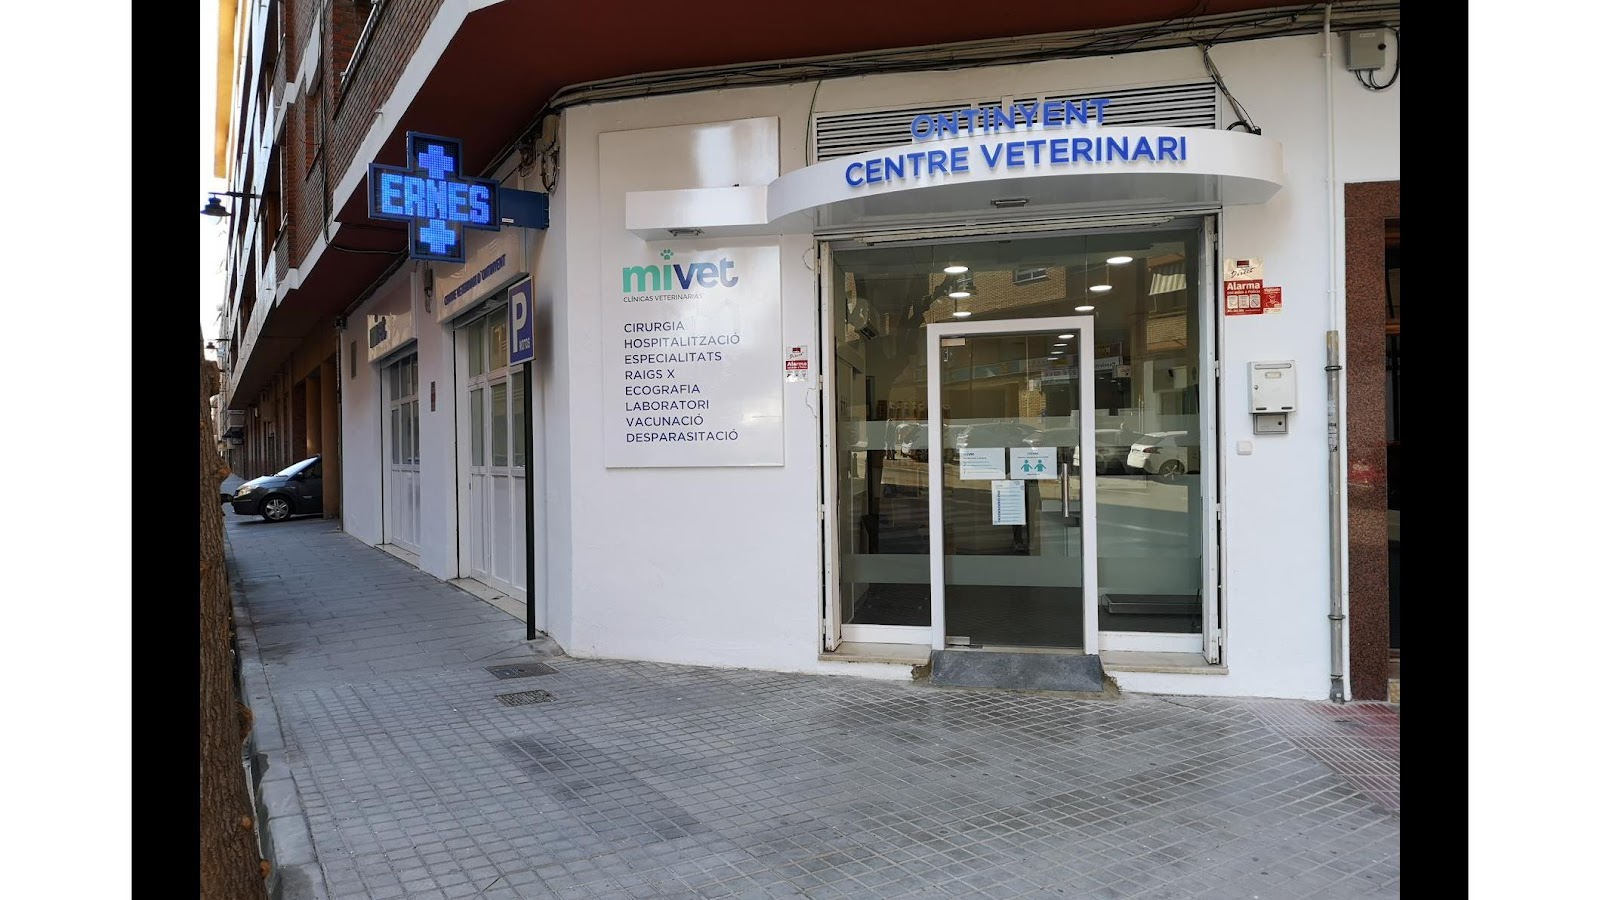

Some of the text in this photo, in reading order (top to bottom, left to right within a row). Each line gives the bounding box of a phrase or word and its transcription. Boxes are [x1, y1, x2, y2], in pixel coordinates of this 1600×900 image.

[911, 98, 1110, 140] ONTINYENT
[845, 136, 1187, 187] CENTRE VETERINARI
[381, 172, 490, 225] ERNES
[622, 256, 739, 293] mivet
[1227, 281, 1260, 290] Alarma
[655, 292, 704, 301] VETERINARIAS
[511, 291, 528, 353] P
[624, 321, 685, 333] CIRURGIA
[624, 332, 740, 349] HOSPITALITZACIÓ
[624, 351, 722, 365] ESPECIALITATS
[625, 368, 676, 380] RAIGS X
[625, 384, 701, 396] ECOGRAFIA
[625, 399, 709, 412] LABORATORI
[626, 413, 704, 427] VACUNACIÓ
[626, 428, 739, 443] DESPARASITACIÓ
